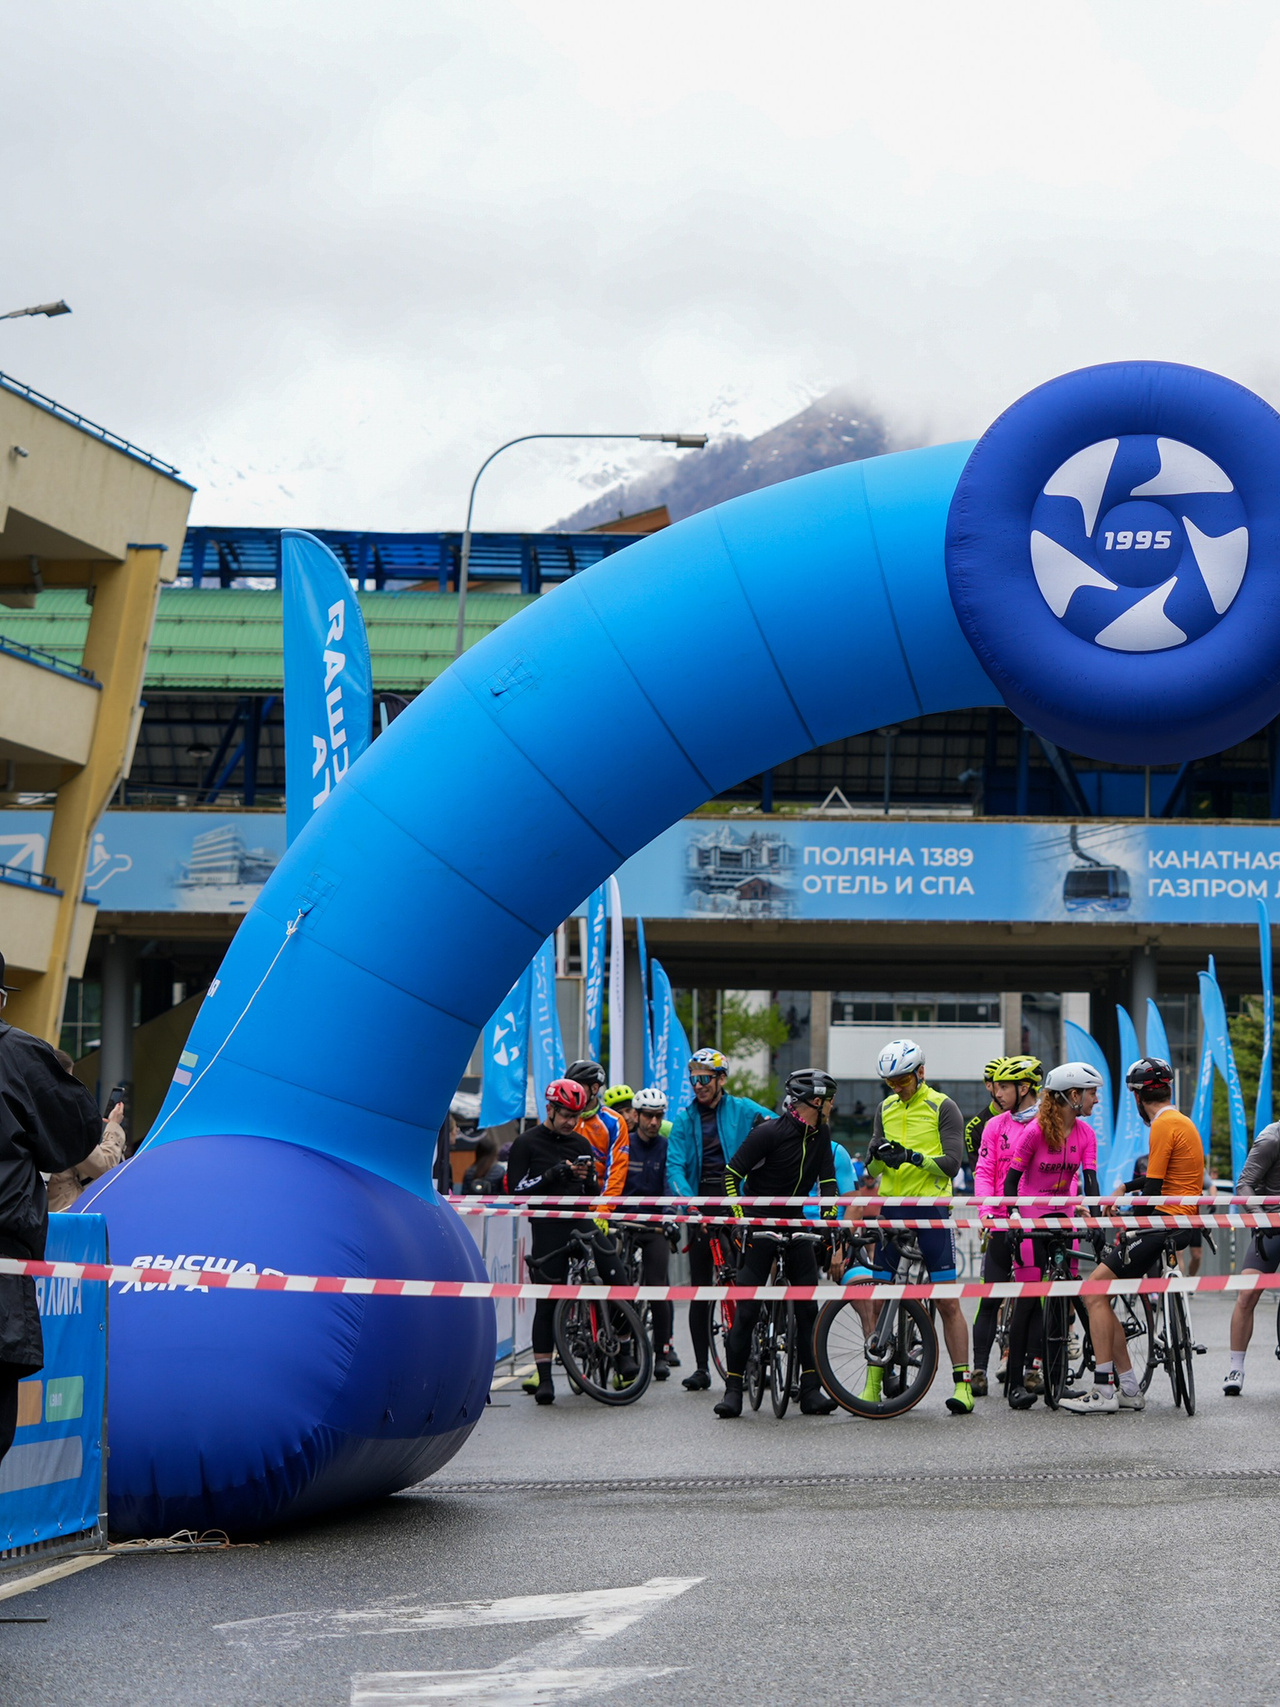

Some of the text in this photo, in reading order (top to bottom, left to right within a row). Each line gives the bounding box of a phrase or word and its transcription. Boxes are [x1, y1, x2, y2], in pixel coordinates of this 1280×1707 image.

[1104, 530, 1172, 550] 1995
[803, 846, 974, 867] ПОЛЯНА 1389
[802, 875, 975, 895] ОТЕЛЬ И СПА
[1148, 879, 1268, 899] ГАЗПРОМ
